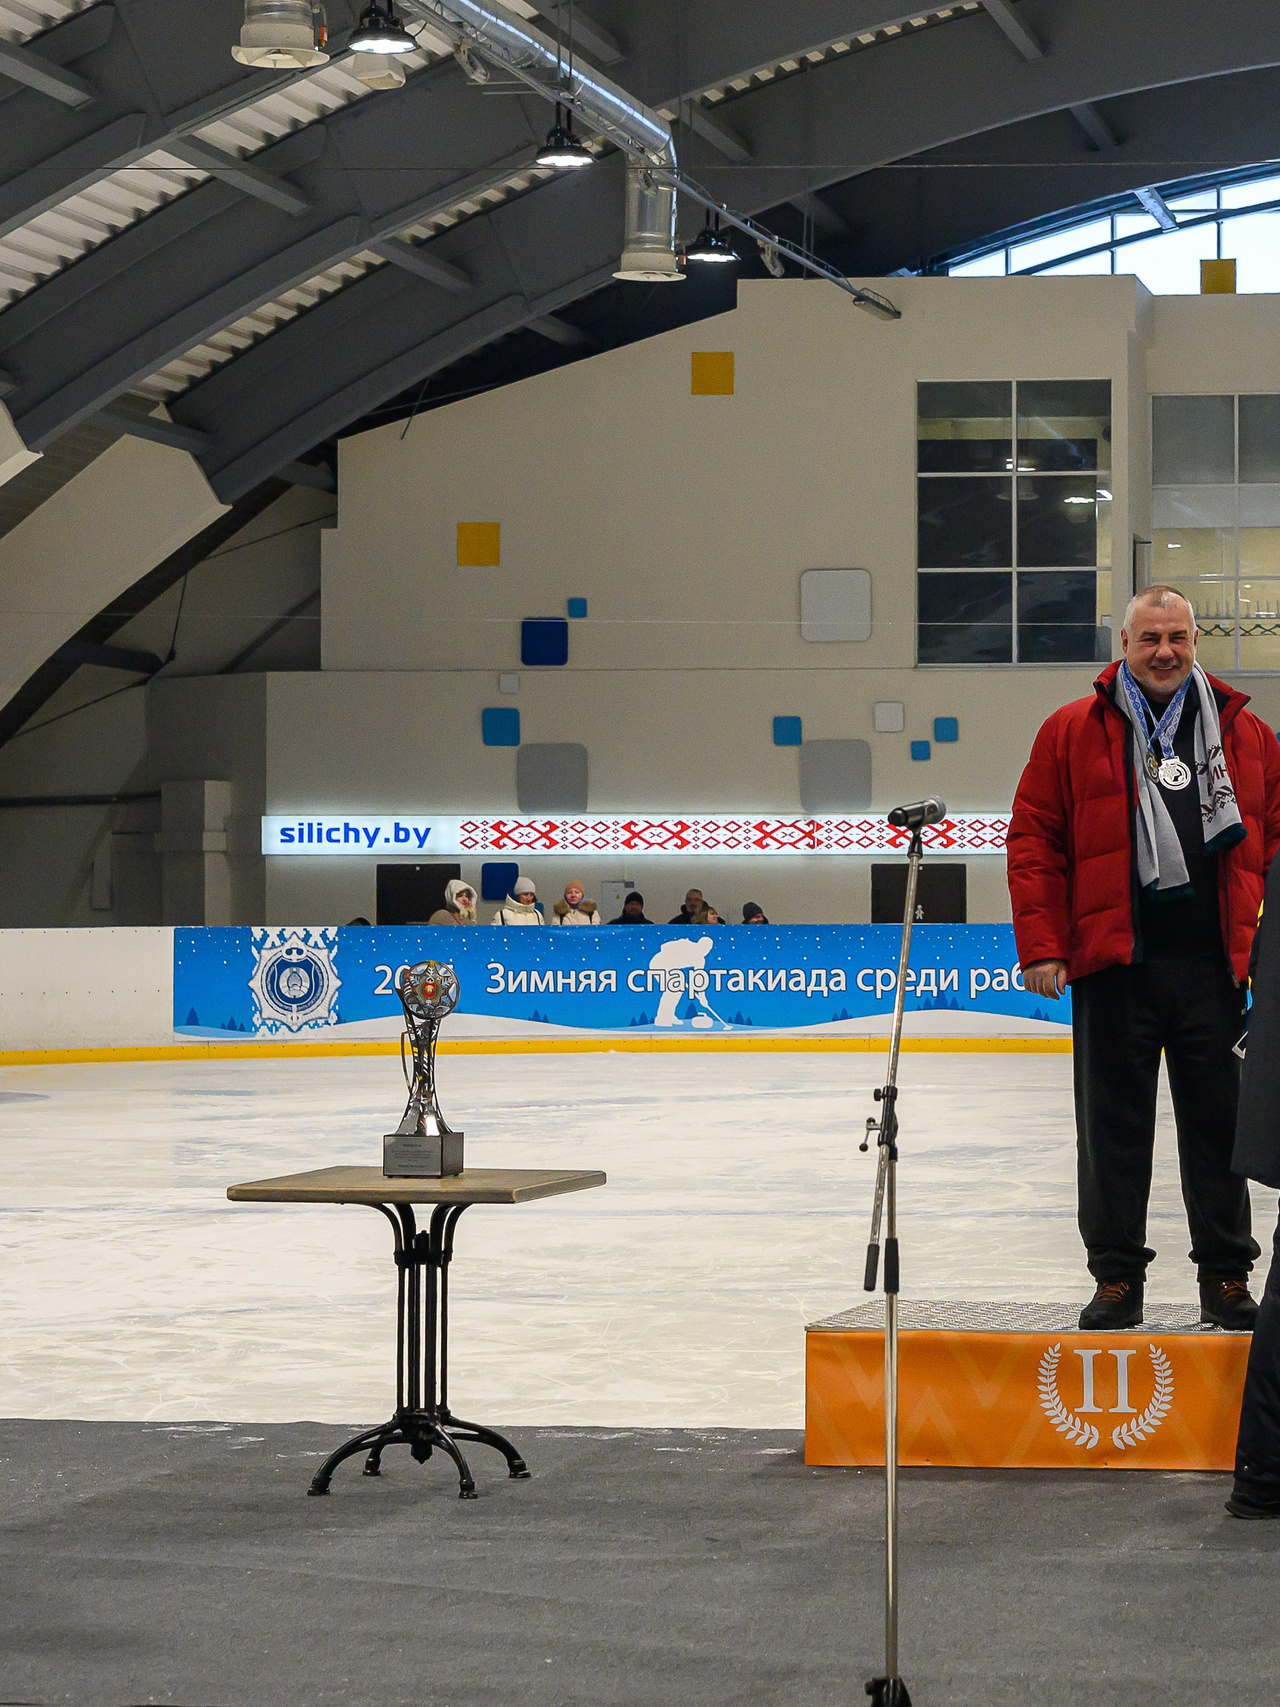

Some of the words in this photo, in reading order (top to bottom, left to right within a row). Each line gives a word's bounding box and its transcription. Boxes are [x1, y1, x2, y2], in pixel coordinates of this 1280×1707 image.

[280, 822, 432, 848] silichy.by
[486, 962, 618, 994] Зимняя
[626, 967, 847, 999] спартакиада
[856, 967, 959, 998] среди
[1073, 1349, 1138, 1413] II
